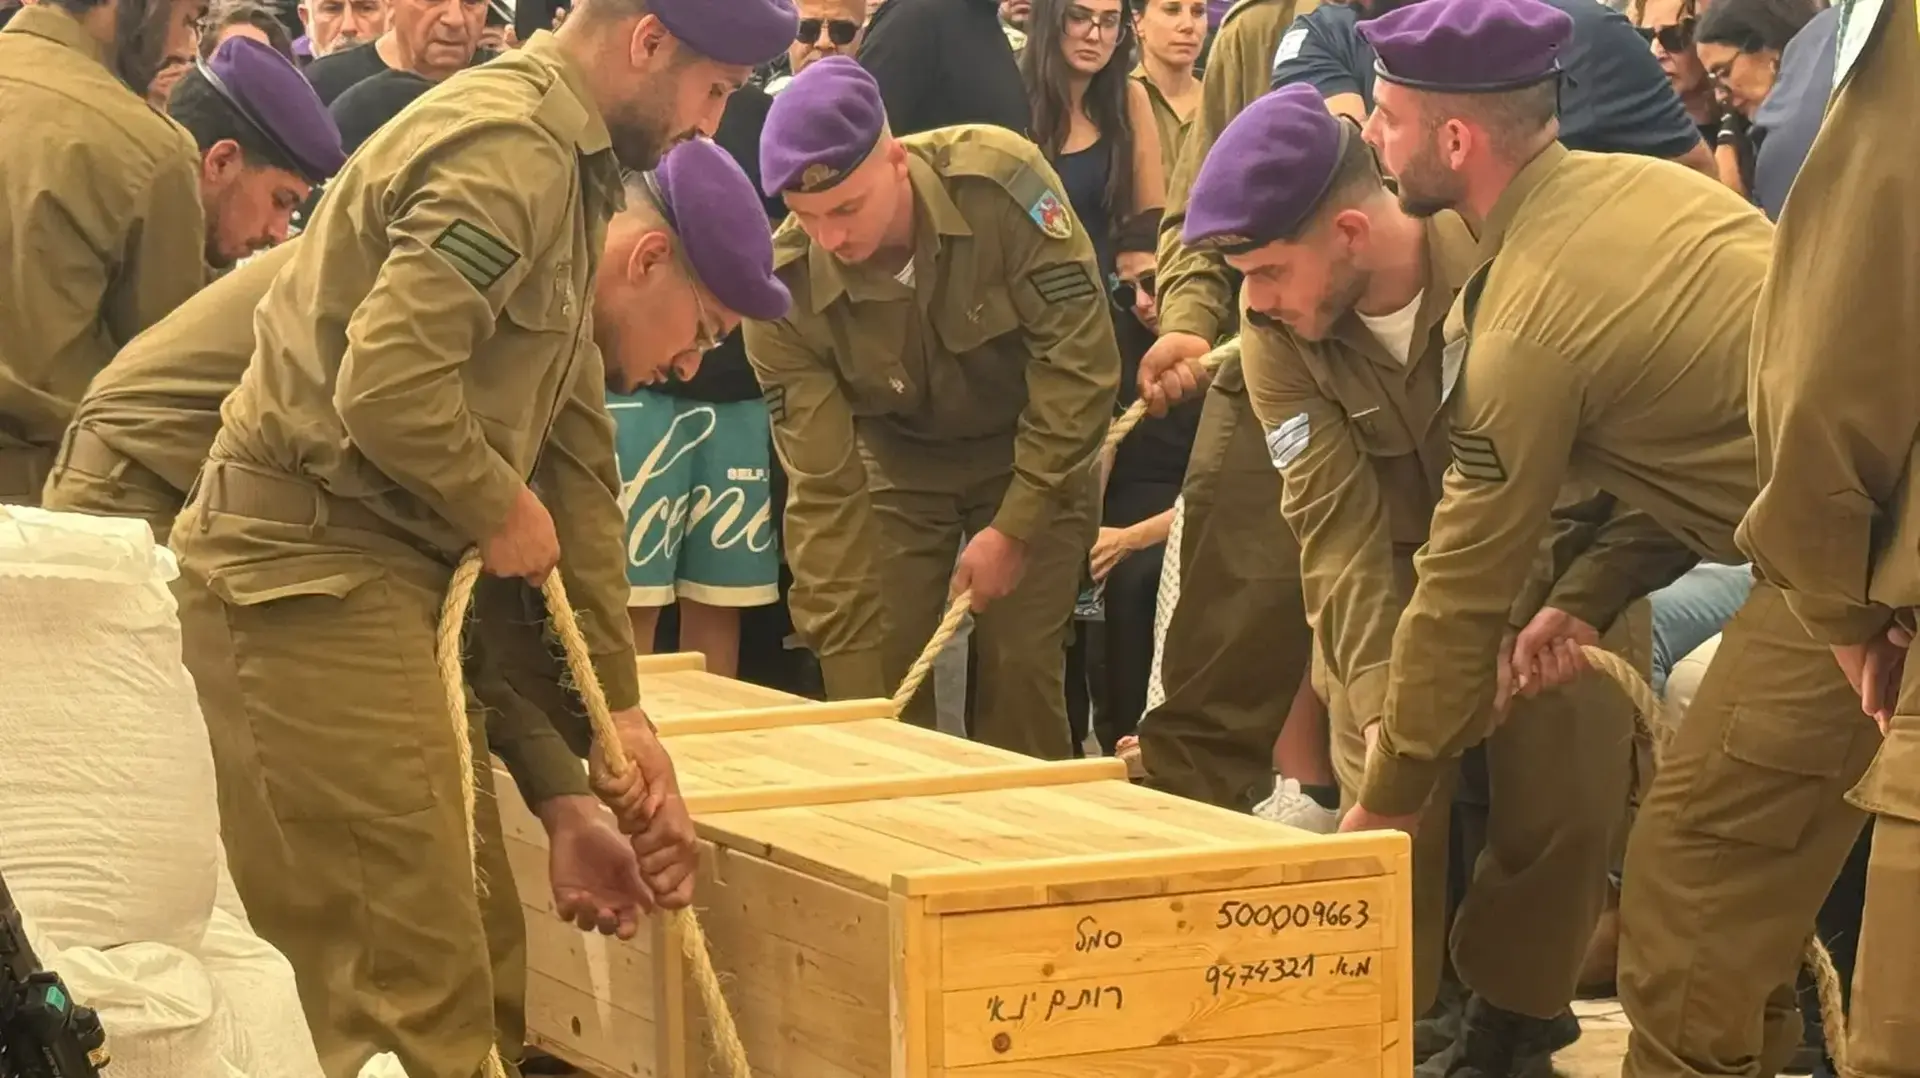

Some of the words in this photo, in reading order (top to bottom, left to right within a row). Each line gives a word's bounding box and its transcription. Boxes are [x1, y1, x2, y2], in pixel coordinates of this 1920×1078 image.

[1216, 899, 1369, 931] 500009663
[1075, 915, 1123, 954] סמל
[1205, 953, 1315, 996] 9474321
[1044, 986, 1123, 1022] רותם
